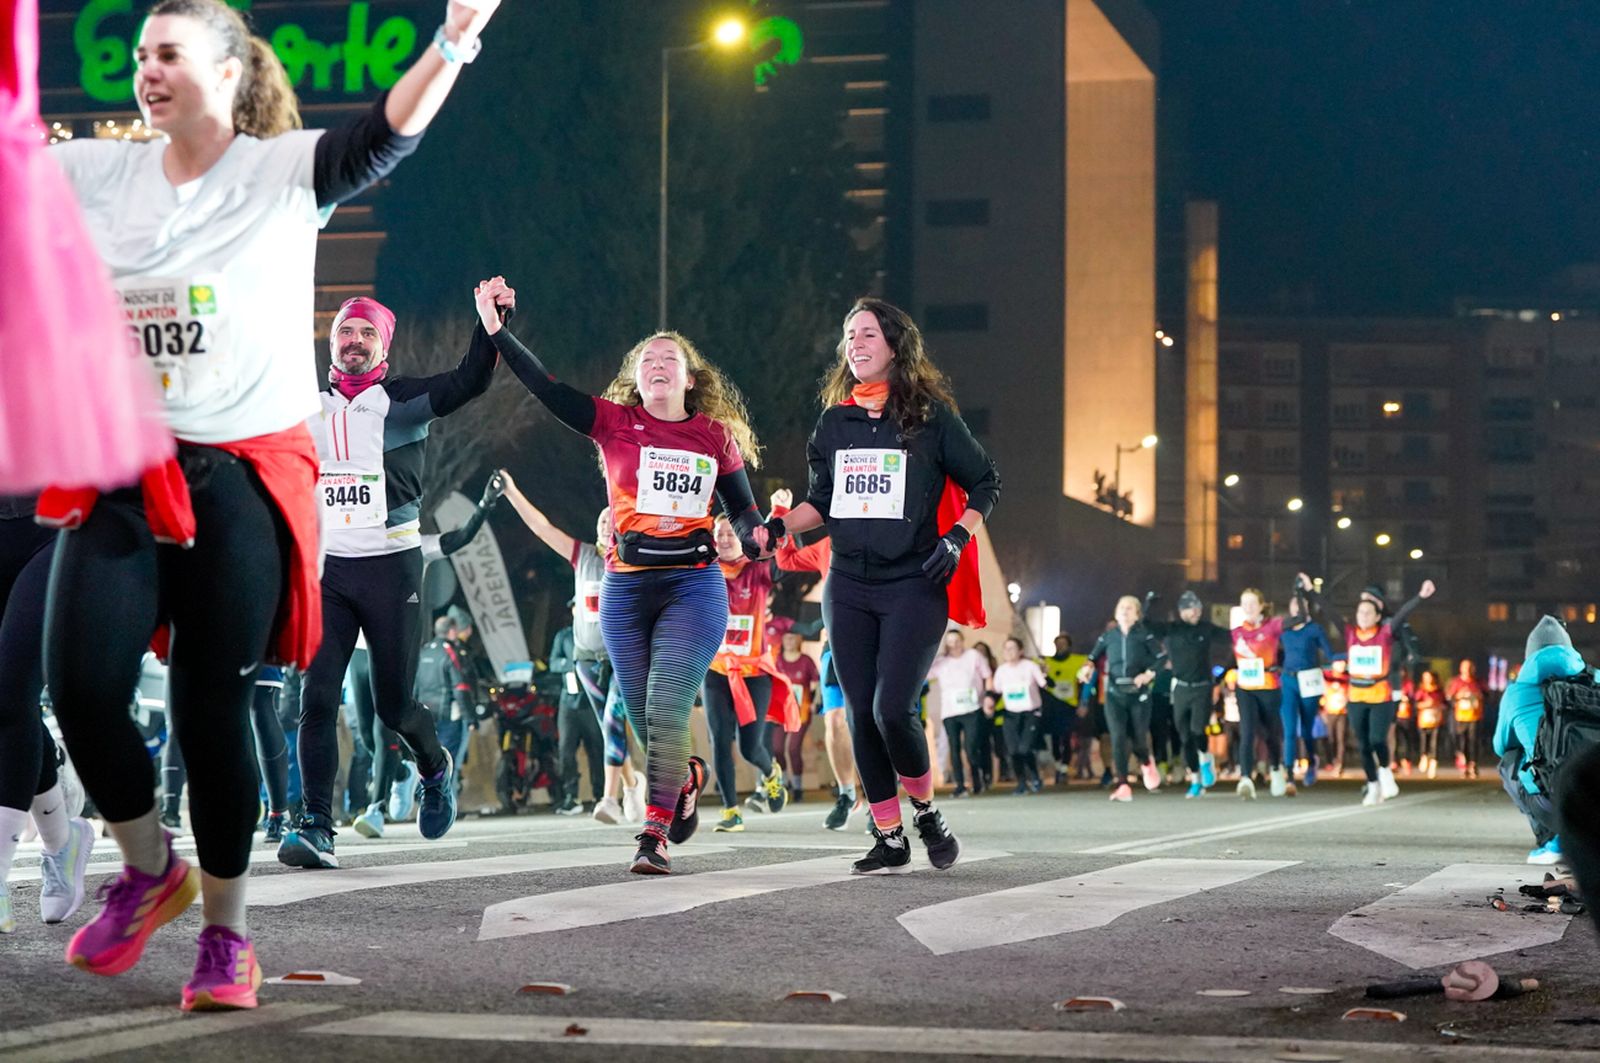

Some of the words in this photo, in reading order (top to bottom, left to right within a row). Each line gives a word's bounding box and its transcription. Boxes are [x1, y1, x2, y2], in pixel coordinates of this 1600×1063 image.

[123, 293, 158, 305] NOCHE
[162, 291, 175, 304] DE
[125, 320, 206, 358] 6032
[843, 465, 854, 473] SAN
[653, 470, 702, 495] 5834
[845, 474, 891, 494] 6685
[325, 485, 370, 506] 3446
